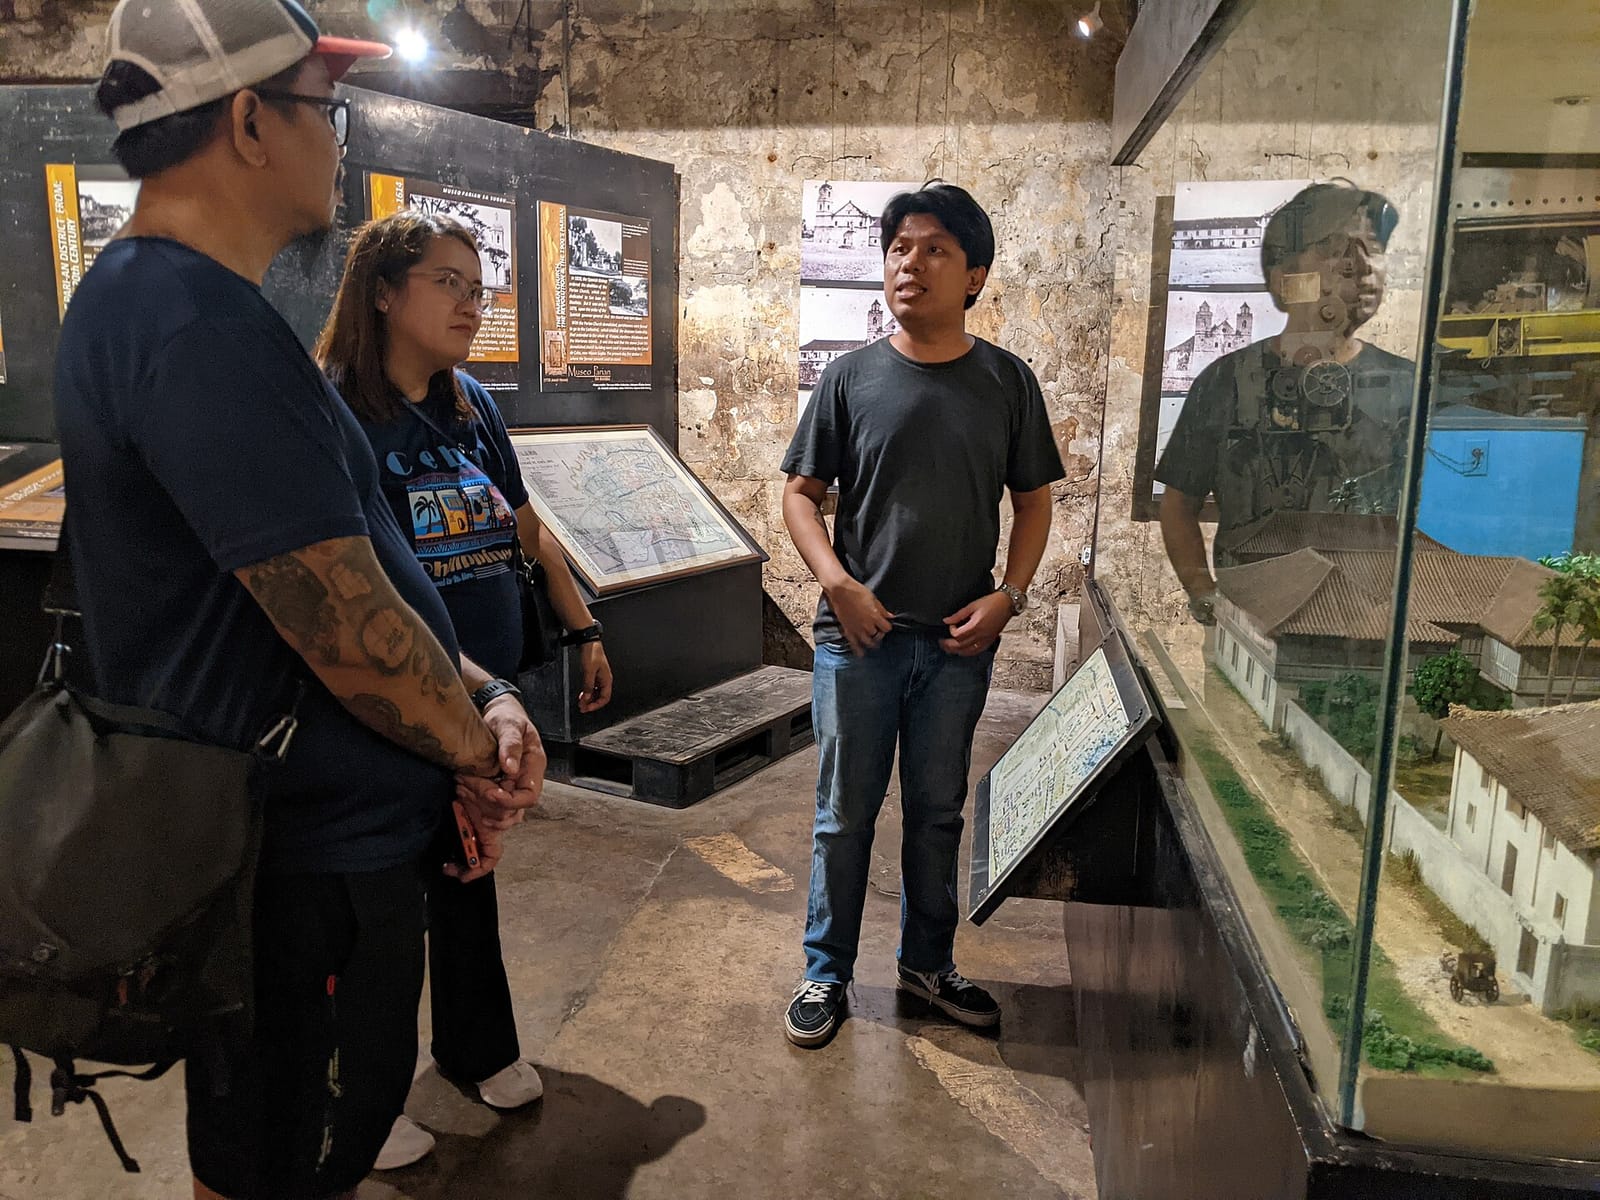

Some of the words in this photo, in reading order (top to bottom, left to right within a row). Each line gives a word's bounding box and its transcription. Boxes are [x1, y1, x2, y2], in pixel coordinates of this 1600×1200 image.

[54, 180, 65, 214] FROM:
[56, 217, 68, 261] DISTRICT
[68, 218, 79, 264] CENTURY
[568, 366, 592, 376] Museo
[593, 365, 611, 377] Parian
[386, 445, 477, 475] Ceb
